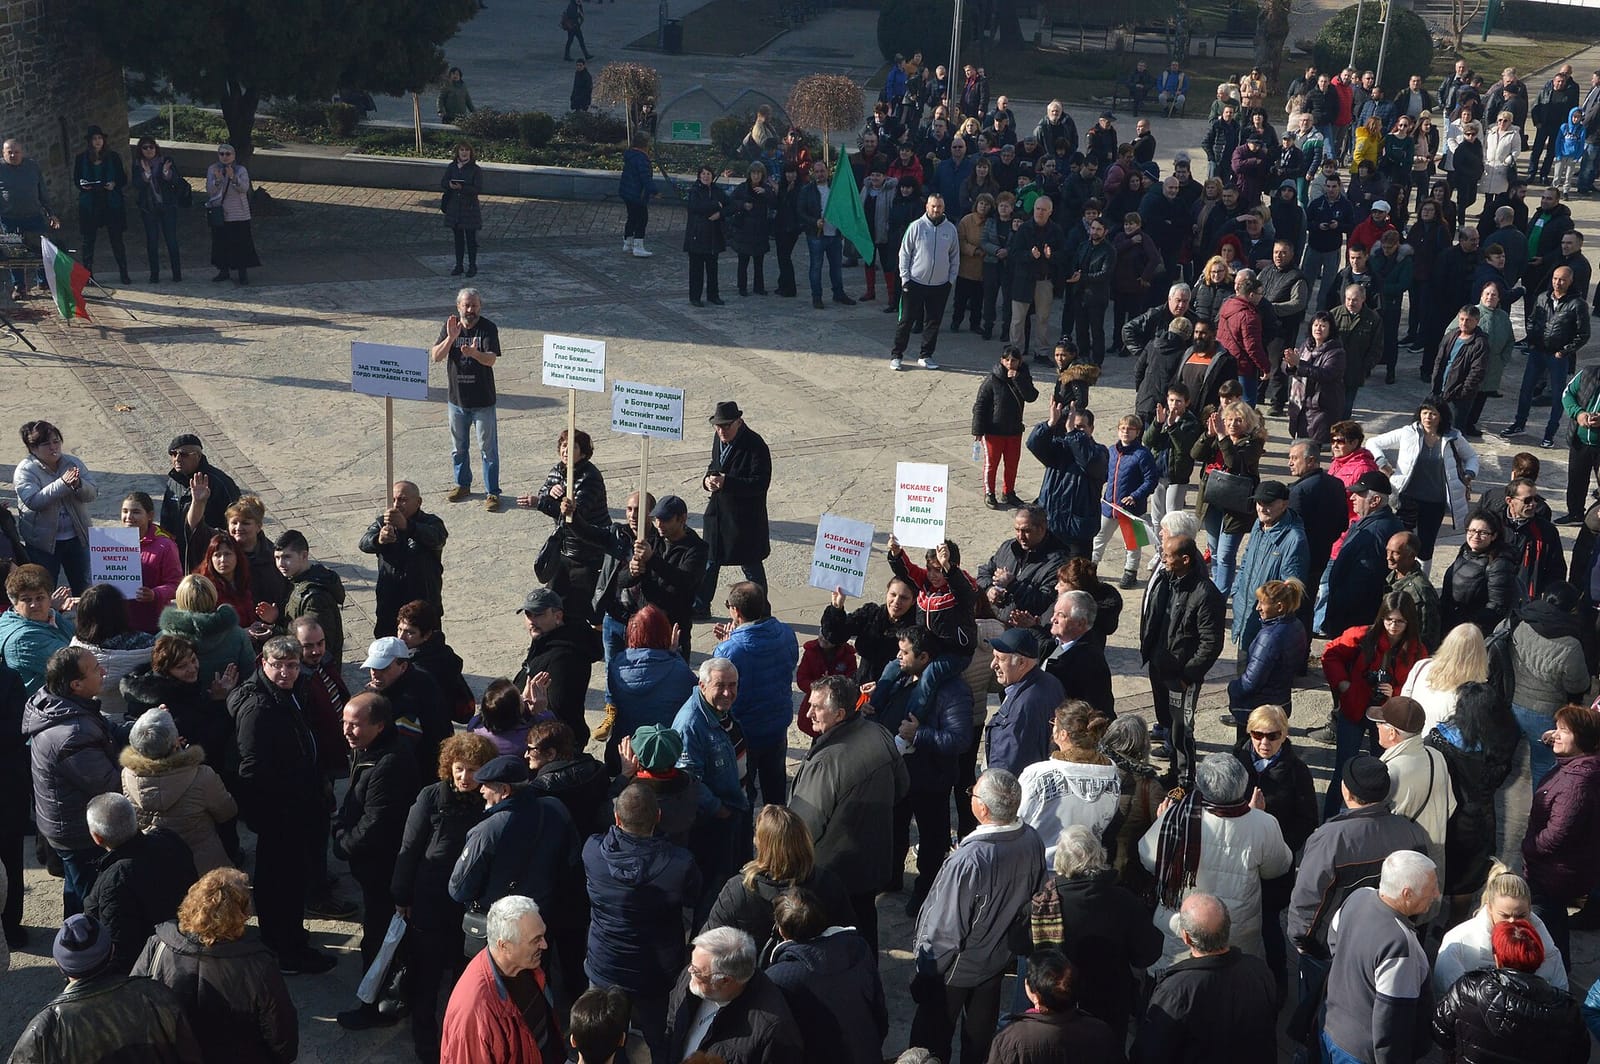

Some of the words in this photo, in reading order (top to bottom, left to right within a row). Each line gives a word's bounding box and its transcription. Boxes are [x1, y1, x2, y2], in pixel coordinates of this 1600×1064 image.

[566, 374, 596, 383] Гавалюгов
[626, 388, 653, 396] искаме
[655, 391, 681, 400] крадци
[631, 399, 670, 411] Ботевград!
[619, 419, 637, 427] Иван
[639, 422, 680, 434] Гавалюгов!
[900, 483, 931, 492] ИСКАМЕ
[908, 495, 935, 503] КМЕТА!
[896, 516, 943, 526] ГАВАЛЮГОВ
[824, 533, 865, 548] ИЗБРАХМЕ
[838, 546, 861, 556] КМЕТ!
[830, 554, 852, 564] ИВАН
[815, 560, 863, 577] ГАВАЛЮГОВ
